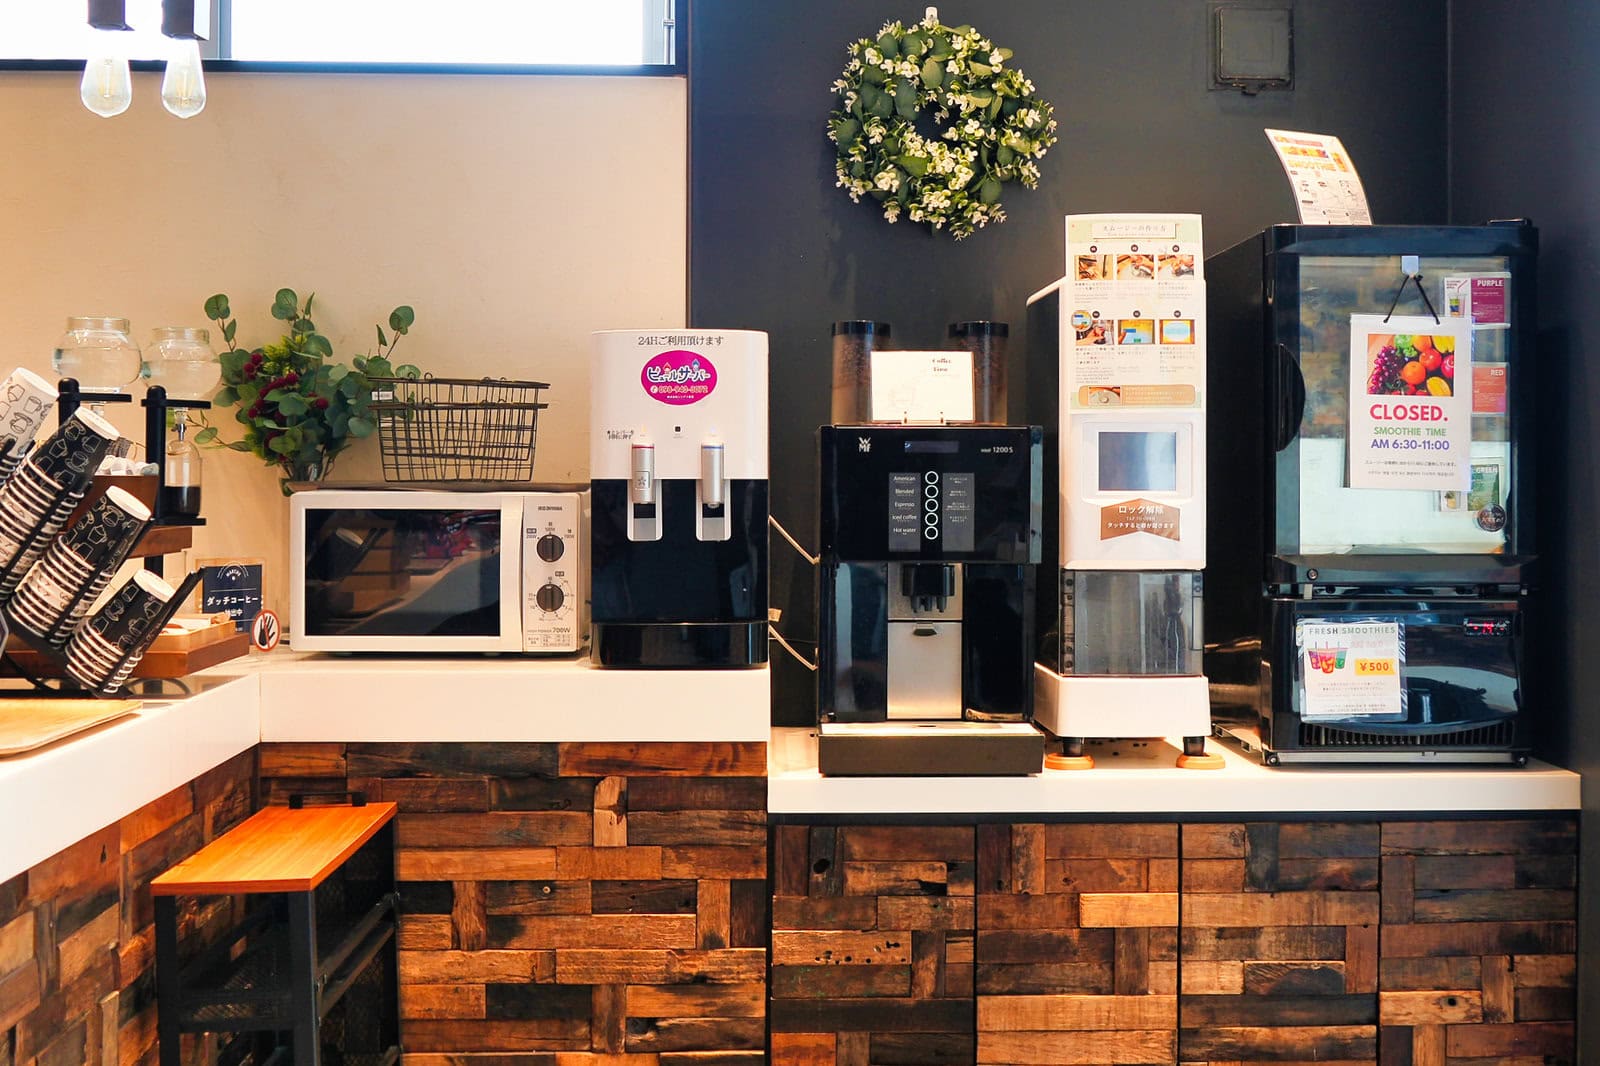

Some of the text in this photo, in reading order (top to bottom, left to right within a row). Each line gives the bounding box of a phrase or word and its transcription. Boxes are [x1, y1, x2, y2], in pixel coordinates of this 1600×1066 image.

[1477, 279, 1503, 287] PURPLE
[638, 335, 724, 346] 24Hご利用頂けます
[1369, 403, 1449, 422] CLOSED.
[1374, 426, 1447, 437] SMOOTHIE TIME
[1371, 438, 1450, 450] AM 6:30-11:00
[207, 596, 259, 607] ダッチコーヒー
